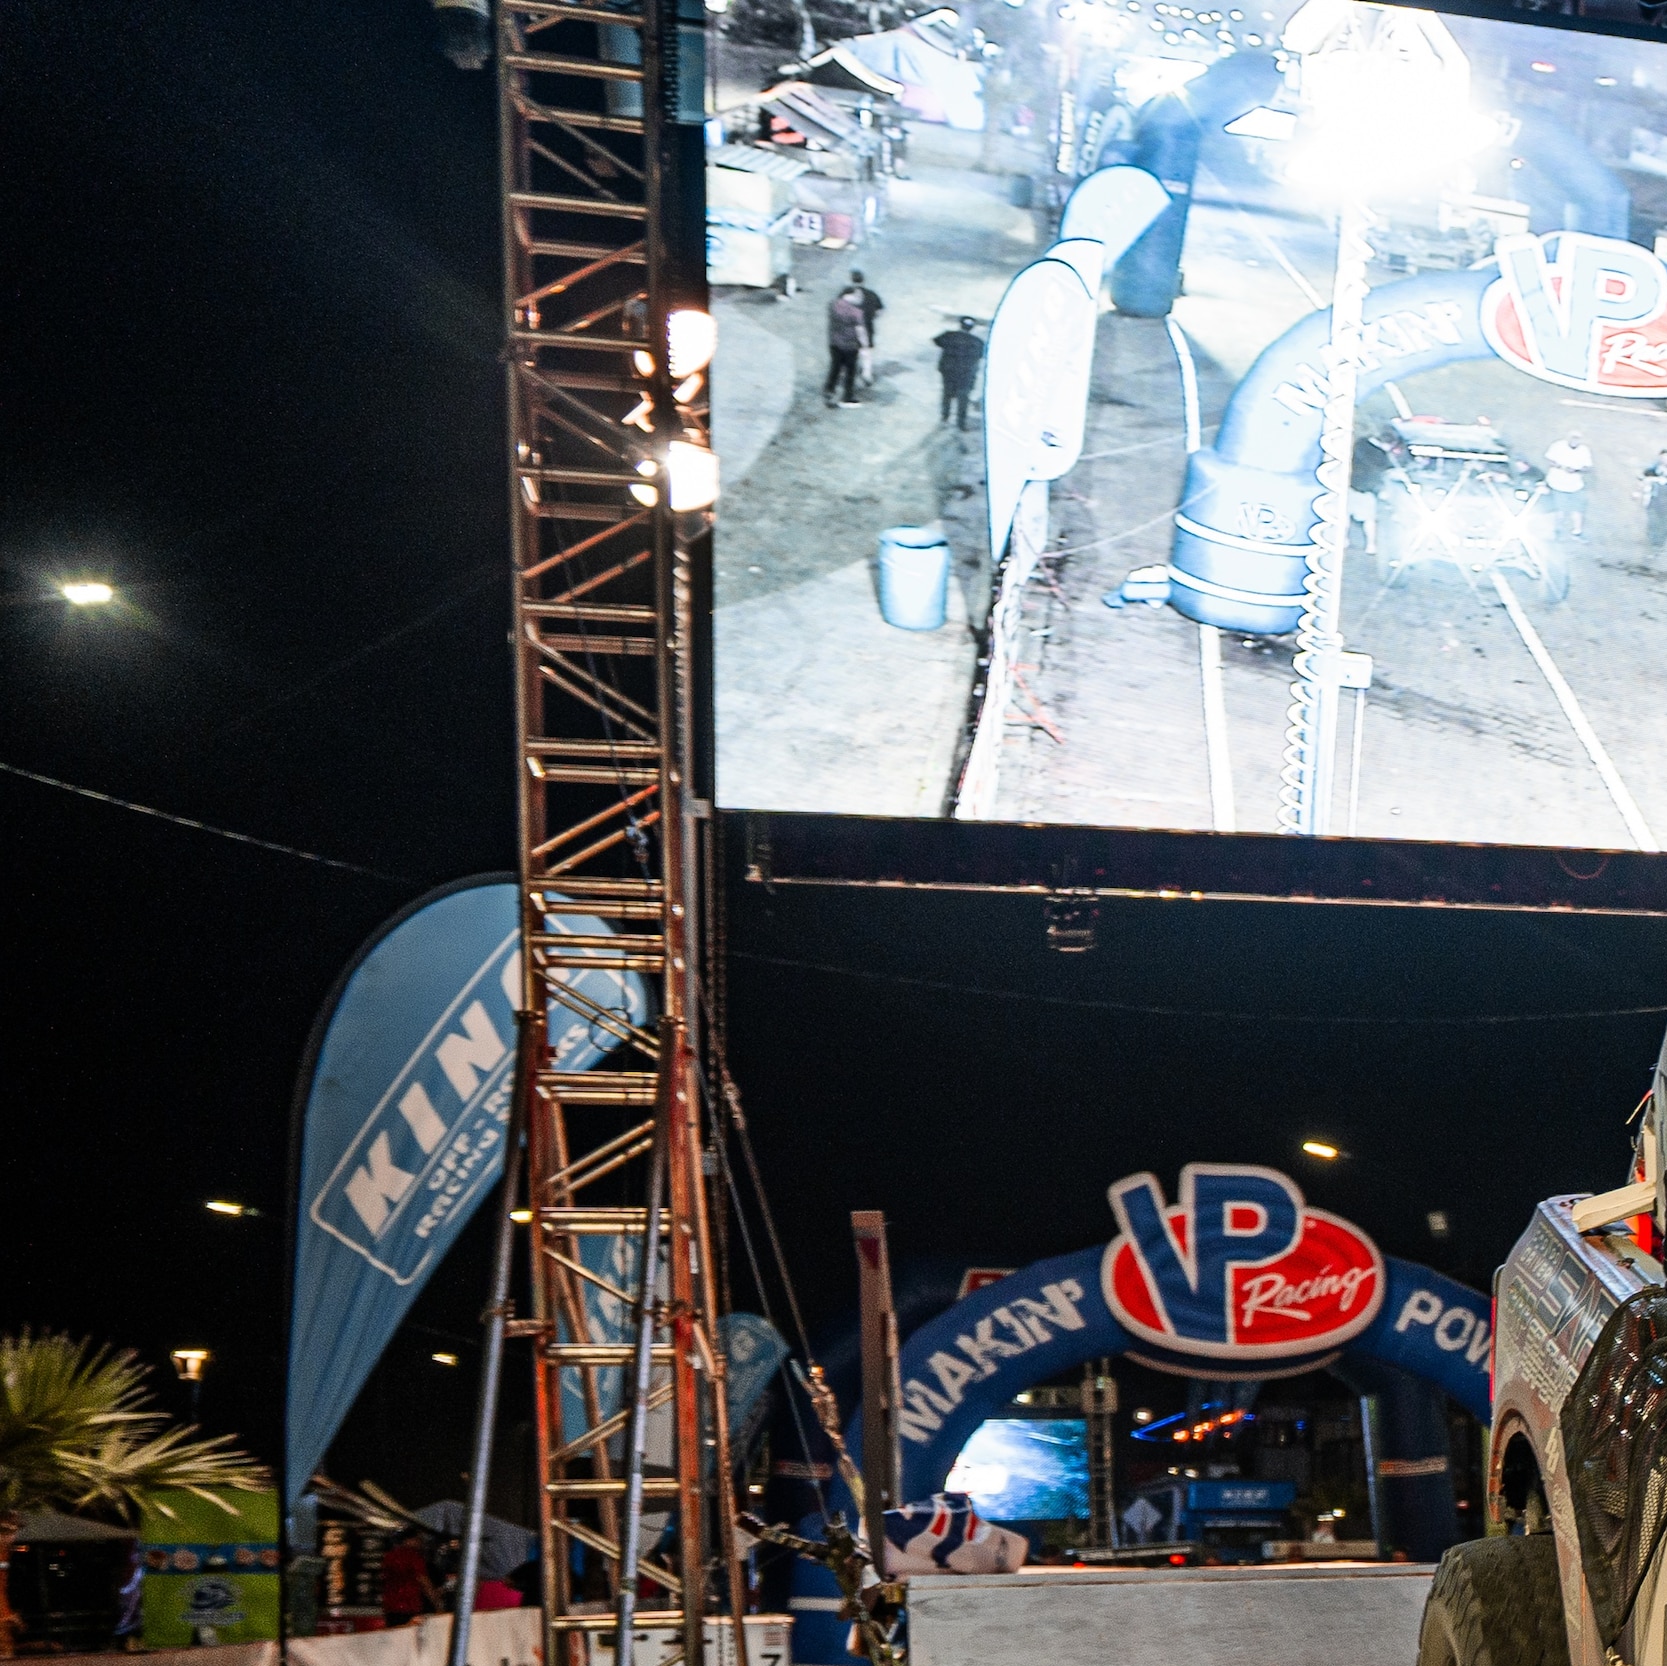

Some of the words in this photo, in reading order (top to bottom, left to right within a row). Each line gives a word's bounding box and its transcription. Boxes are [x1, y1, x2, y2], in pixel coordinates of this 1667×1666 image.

[1503, 238, 1664, 382] VP
[1109, 1163, 1305, 1347] VP
[1241, 1264, 1378, 1328] Racing
